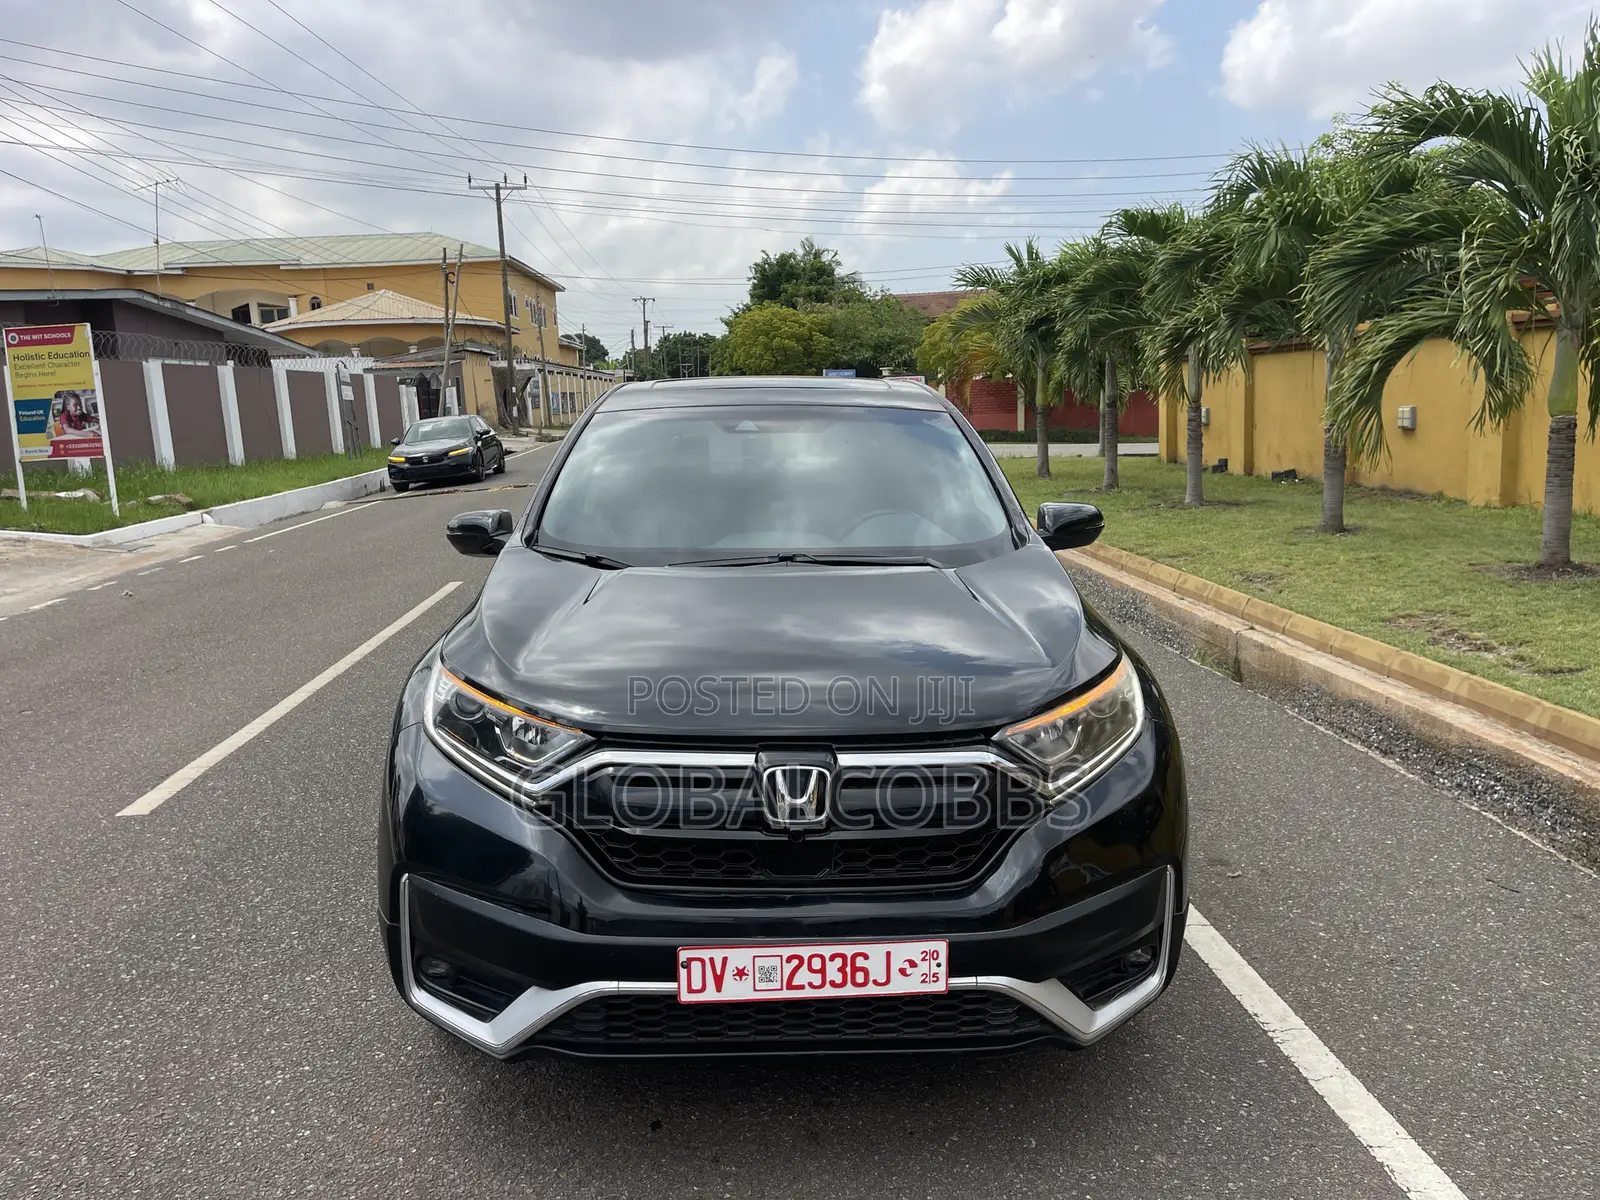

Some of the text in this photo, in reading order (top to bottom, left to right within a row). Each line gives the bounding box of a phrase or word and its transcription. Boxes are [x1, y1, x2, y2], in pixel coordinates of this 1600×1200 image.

[13, 350, 90, 362] Holistic Education
[14, 361, 80, 370] Excellent Character
[15, 371, 38, 379] Begins
[686, 950, 892, 994] DV 2936J
